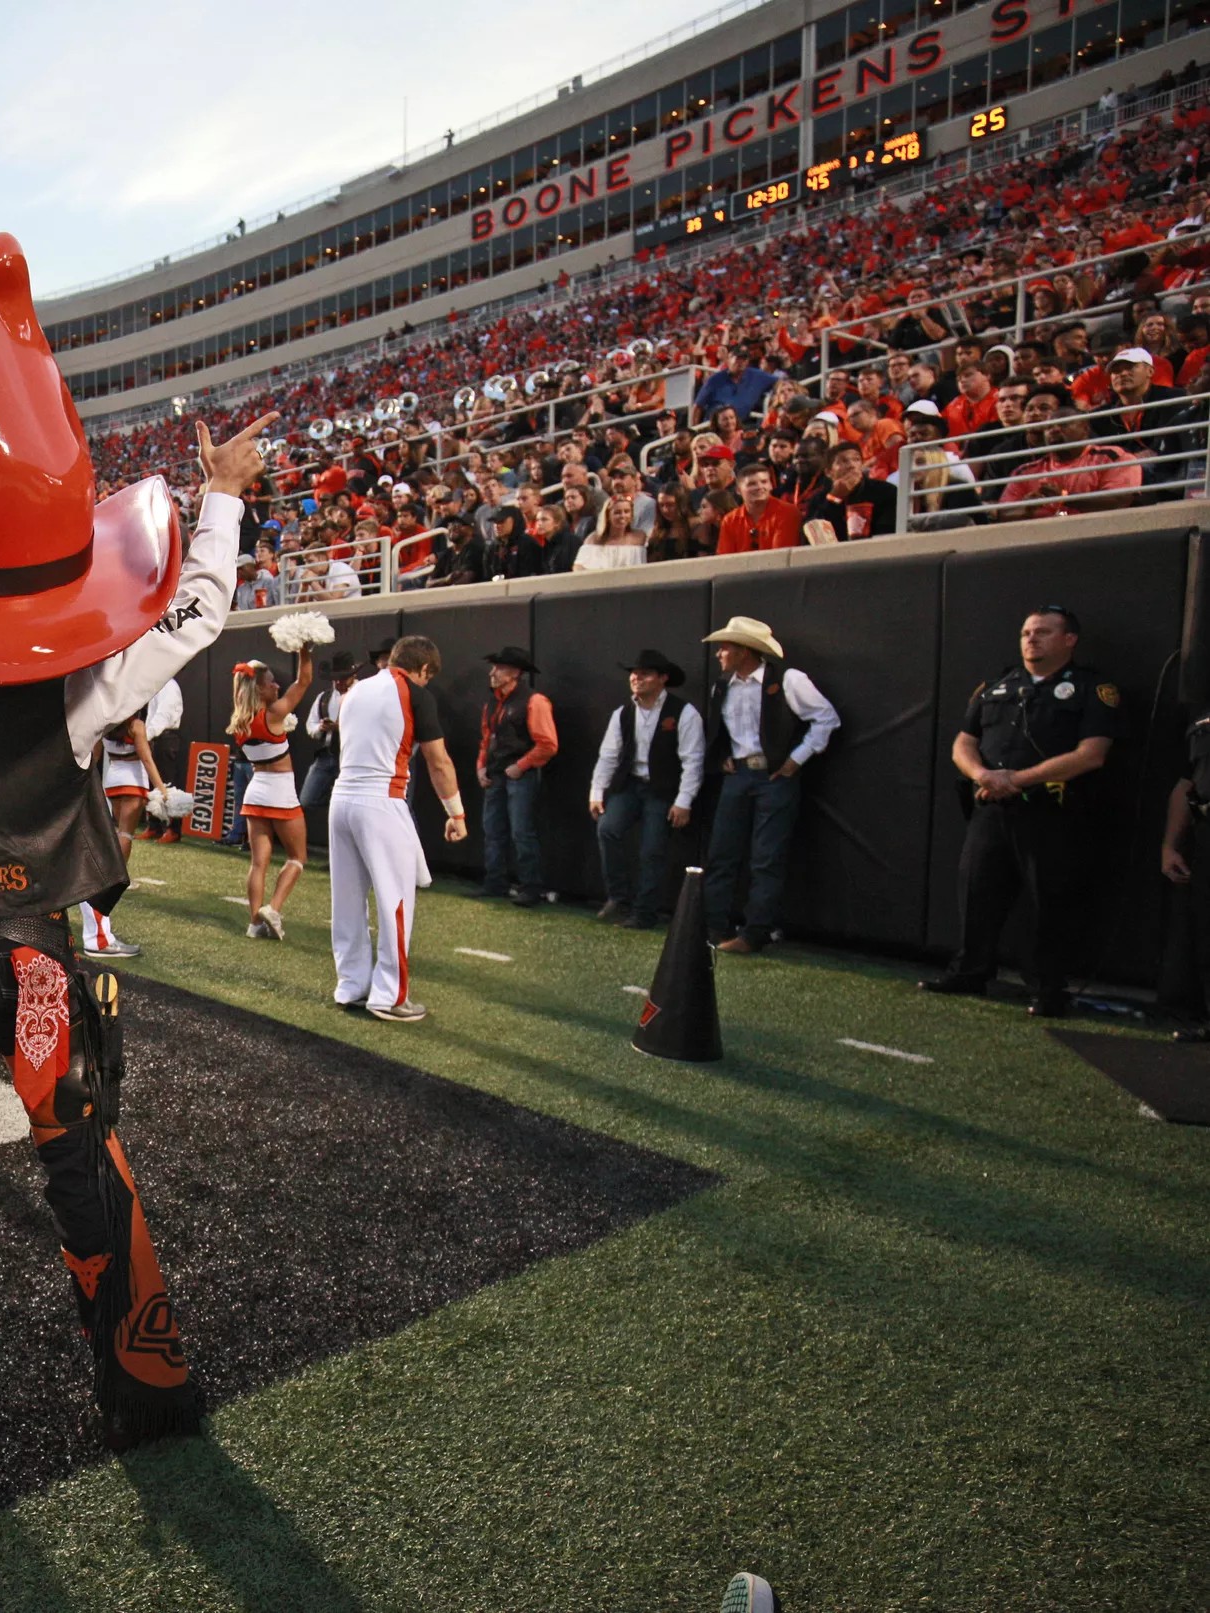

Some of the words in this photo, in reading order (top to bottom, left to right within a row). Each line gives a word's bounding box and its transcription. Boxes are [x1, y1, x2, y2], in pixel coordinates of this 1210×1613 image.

[471, 153, 632, 242] BOONE
[665, 31, 946, 169] PICKENS
[970, 106, 1006, 138] 25
[894, 140, 921, 161] 48
[746, 182, 789, 209] 12:30
[806, 171, 831, 191] 45
[190, 749, 220, 834] ORANGE
